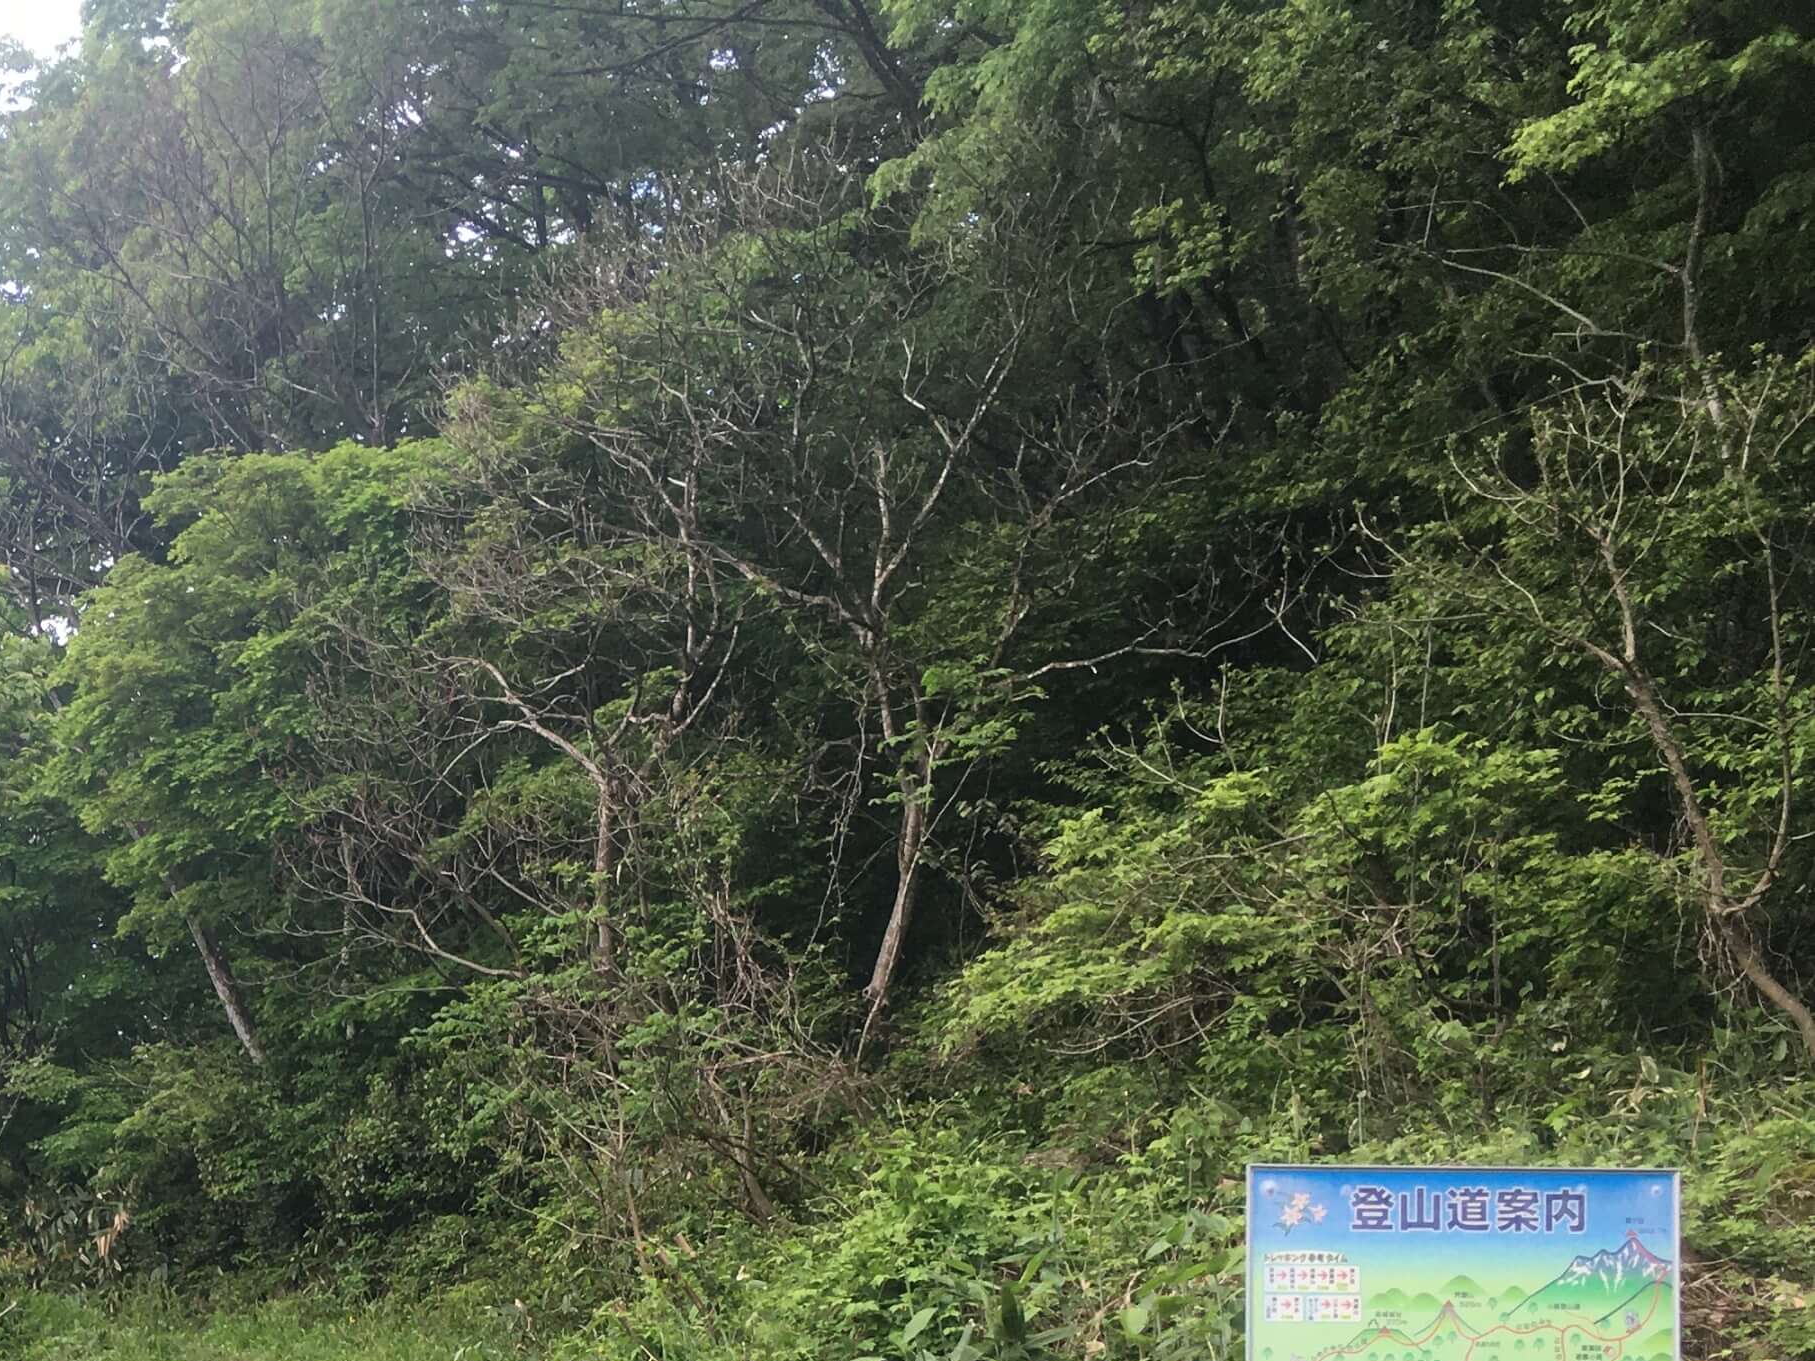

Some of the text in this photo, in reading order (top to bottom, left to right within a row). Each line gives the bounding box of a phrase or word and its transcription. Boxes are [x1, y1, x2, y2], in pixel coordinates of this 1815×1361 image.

[1351, 1186, 1586, 1232] 登山道案内
